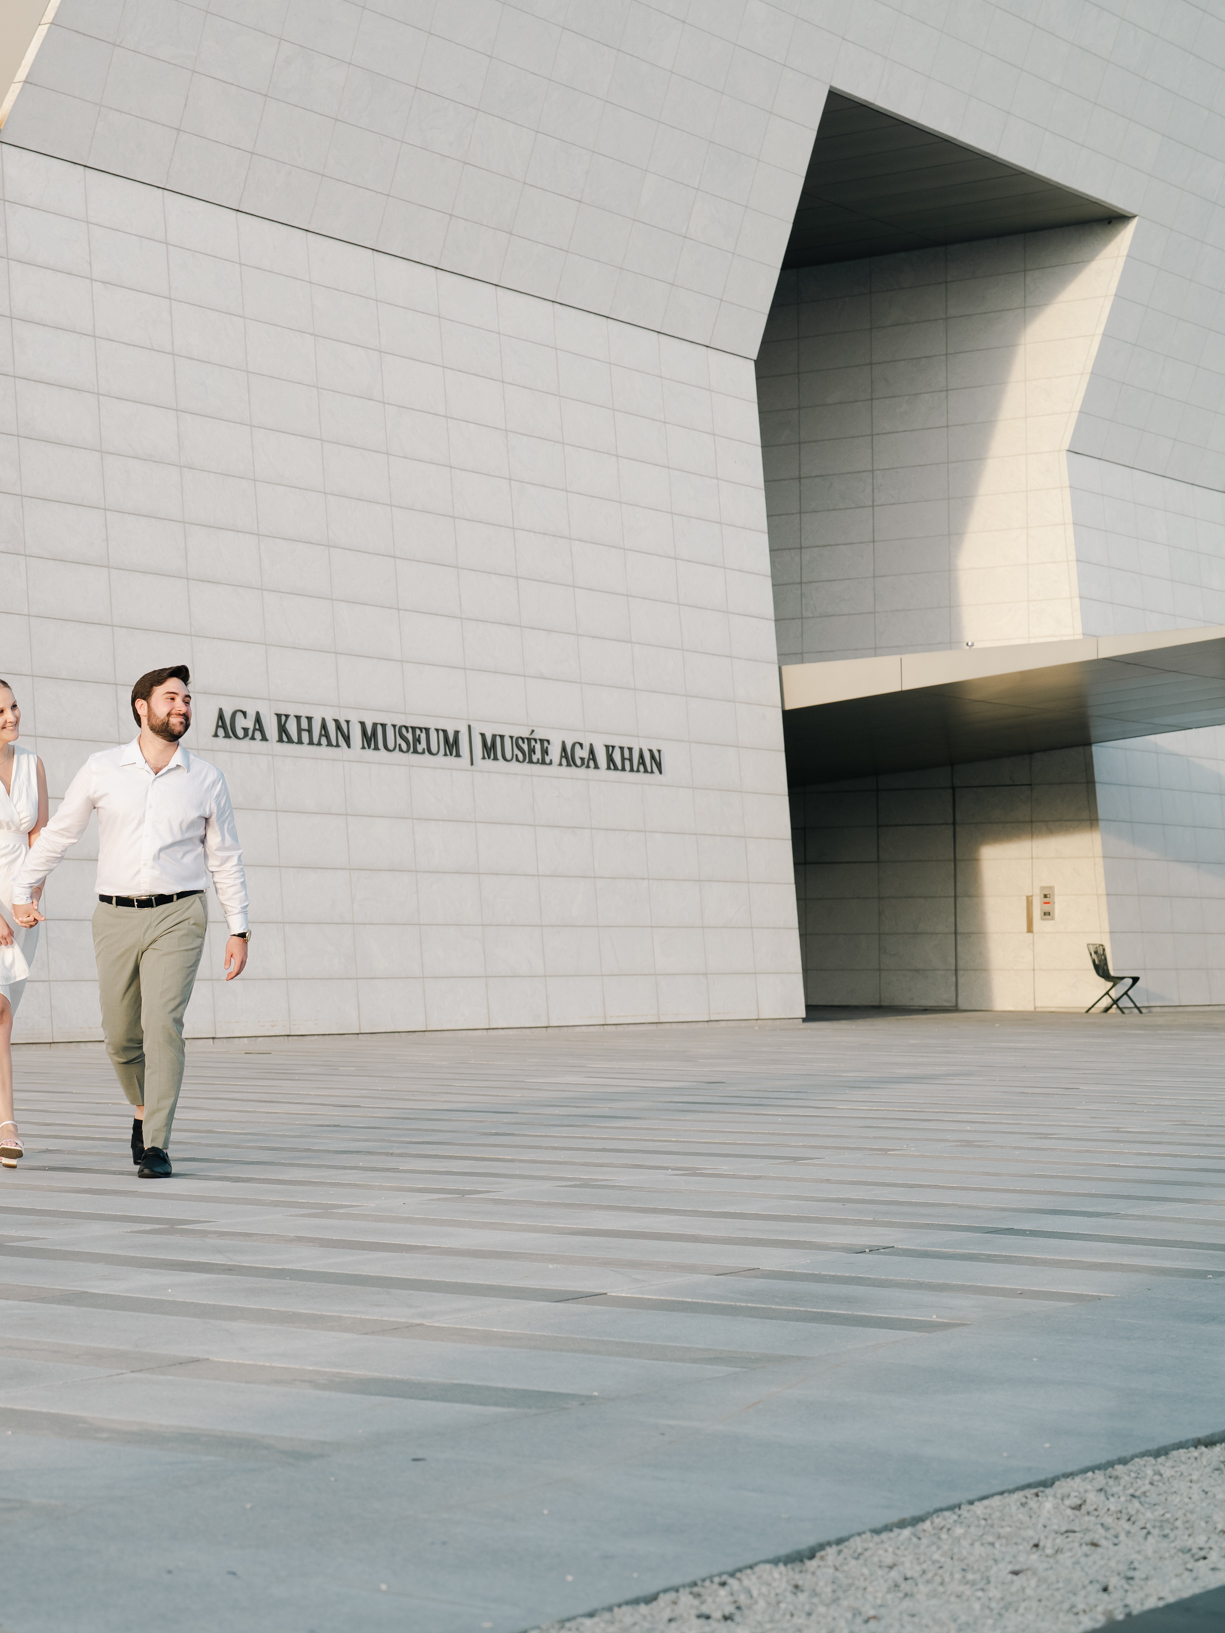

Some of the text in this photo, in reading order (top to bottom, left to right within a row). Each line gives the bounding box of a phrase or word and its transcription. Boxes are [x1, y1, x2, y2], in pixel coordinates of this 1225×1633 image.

[212, 708, 663, 775] AGA KHAN MUSEUM MUSÉE AGA KHAN
